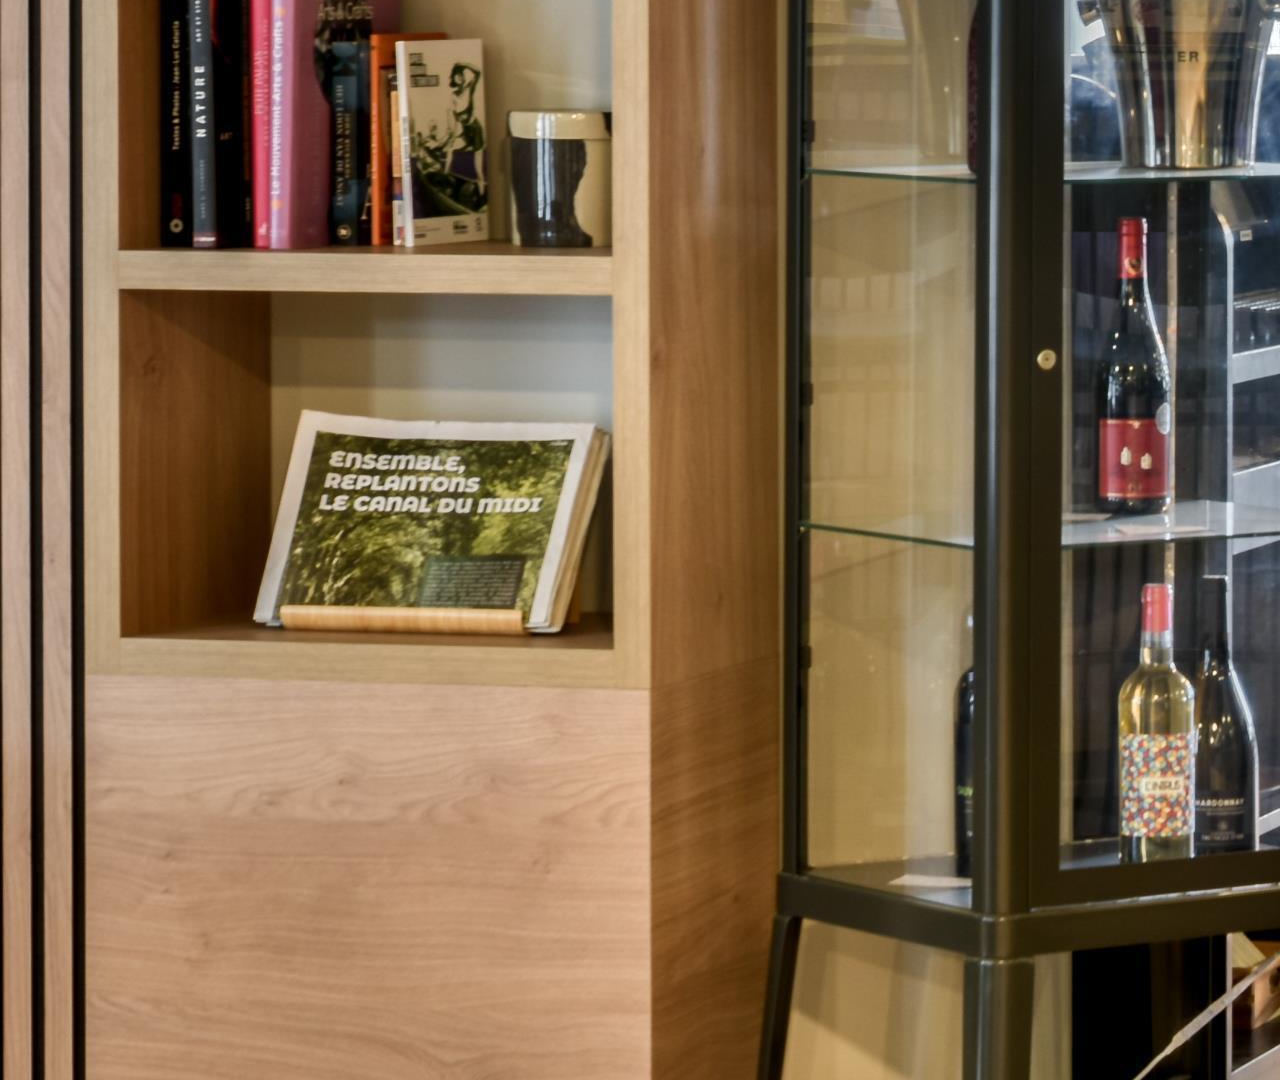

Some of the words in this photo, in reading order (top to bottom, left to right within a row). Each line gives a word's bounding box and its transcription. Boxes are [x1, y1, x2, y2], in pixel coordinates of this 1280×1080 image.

[273, 22, 283, 57] Crafts
[273, 75, 283, 101] Arts
[194, 65, 207, 138] NATURE
[271, 106, 282, 176] Mouvement
[271, 179, 280, 195] Le
[329, 450, 467, 474] ENSEMBLE,
[323, 473, 481, 493] REPLANTONS
[319, 494, 350, 512] LE
[353, 495, 433, 513] CANAL
[436, 497, 473, 514] DU
[477, 496, 543, 514] MIDI
